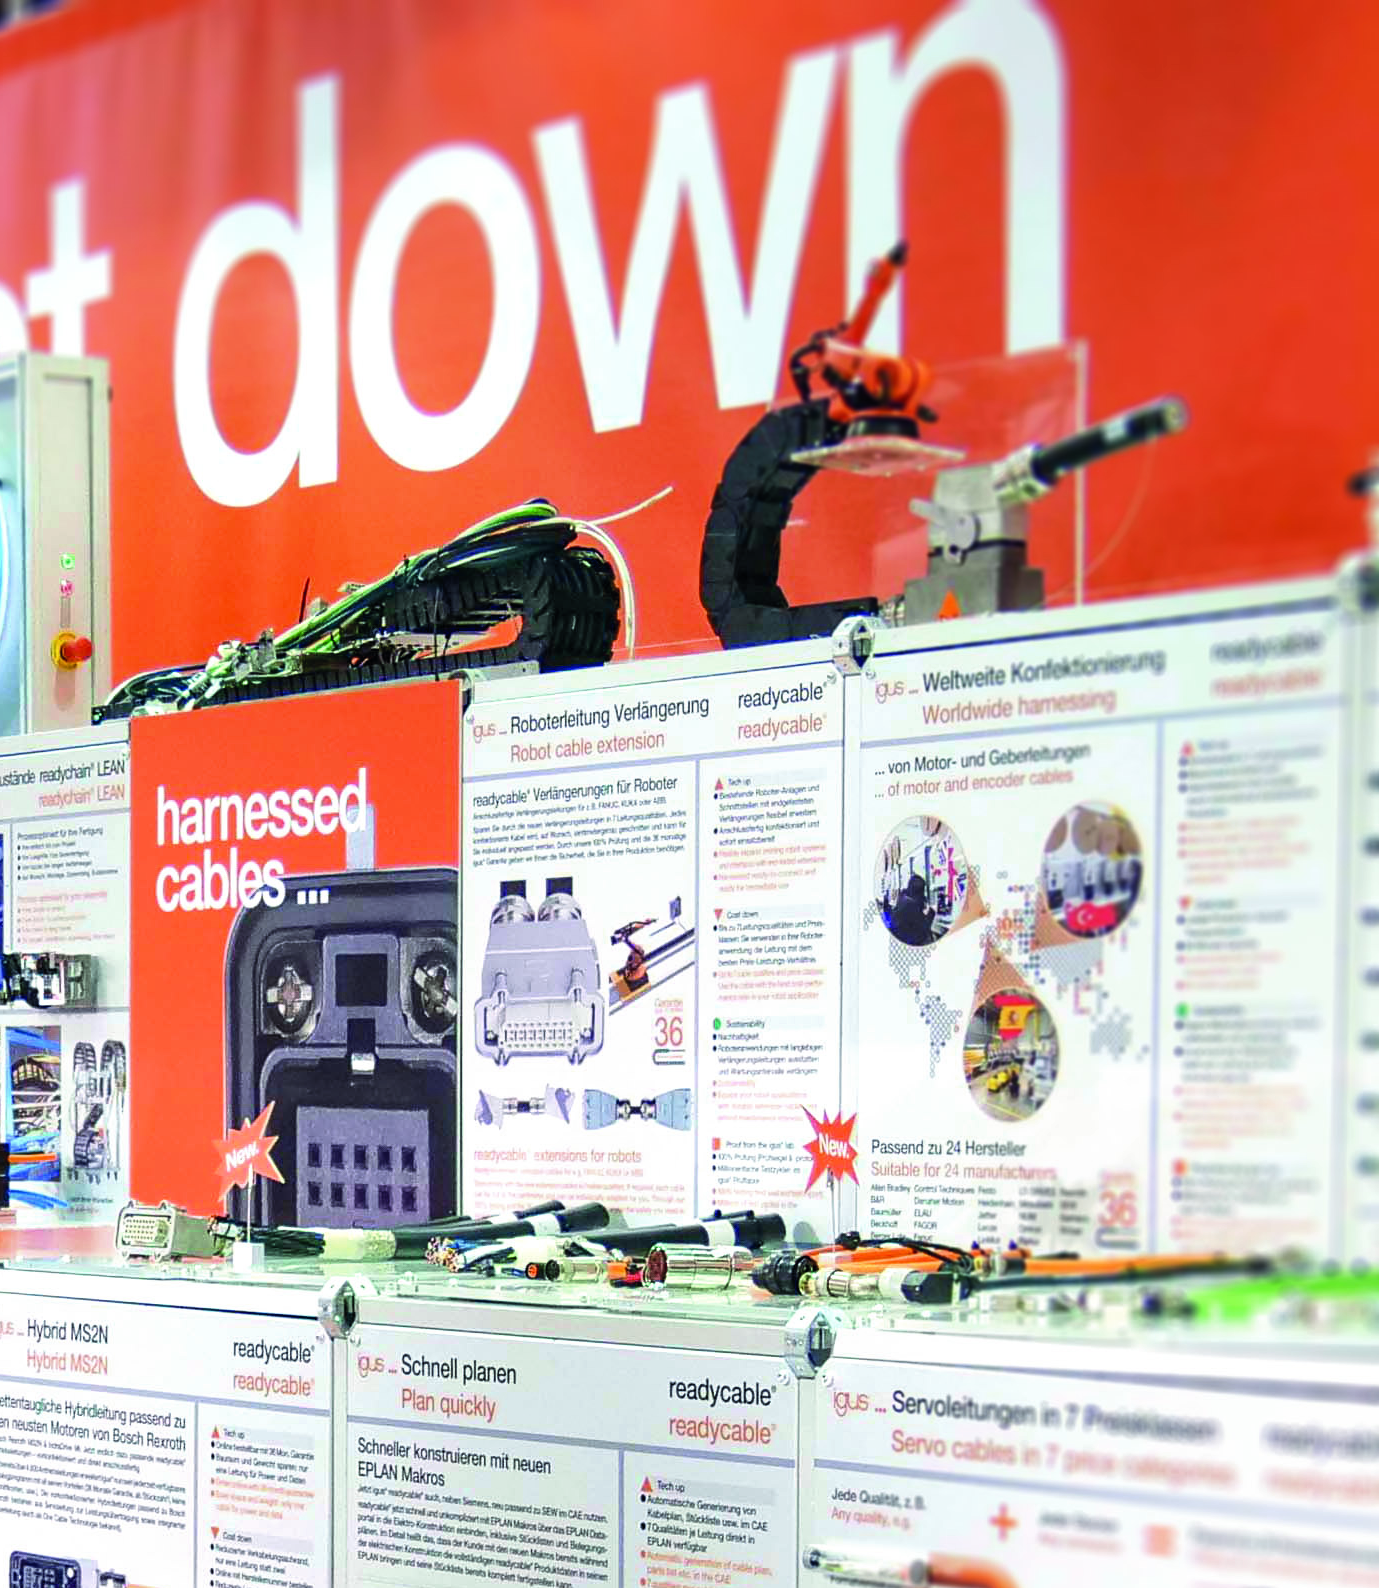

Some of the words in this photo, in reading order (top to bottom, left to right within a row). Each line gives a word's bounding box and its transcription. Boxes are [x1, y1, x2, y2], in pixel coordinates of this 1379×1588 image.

[174, 0, 1068, 507] down
[923, 669, 1005, 693] Weltweite
[1010, 650, 1165, 684] Konfektionierung
[511, 710, 610, 734] Roboterleitung
[614, 697, 710, 723] Verlängerung
[923, 698, 1013, 725] Worldwide
[1017, 687, 1116, 716] harnessing
[511, 743, 551, 762] Robot
[556, 738, 592, 758] cable
[597, 732, 665, 753] extension
[888, 760, 911, 774] von
[914, 755, 956, 772] Motor-
[960, 751, 985, 768] und
[989, 742, 1091, 767] Geberleitungen
[97, 760, 125, 777] LEAN
[903, 779, 941, 796] motor
[945, 774, 969, 792] and
[972, 771, 1025, 789] encoder
[1029, 766, 1074, 786] cables
[97, 784, 125, 801] LEAN
[534, 783, 613, 801] Verlängerungen
[634, 777, 678, 793] Roboter
[156, 767, 367, 846] harnessed
[156, 848, 286, 912] cables
[655, 1016, 683, 1046] 36
[225, 1141, 260, 1174] New.
[534, 1150, 587, 1162] extensions
[591, 1150, 604, 1163] for
[608, 1150, 641, 1163] robots
[819, 1132, 849, 1159] New.
[871, 1139, 924, 1155] Passend
[928, 1143, 941, 1155] zu
[947, 1141, 961, 1155] 24
[966, 1141, 1026, 1156] Hersteller
[871, 1161, 919, 1177] Suitable
[924, 1163, 940, 1177] for
[945, 1163, 959, 1177] 24
[964, 1163, 1057, 1181] manufacturers
[27, 1318, 67, 1343] Hybrid
[71, 1322, 108, 1344] MS2N
[27, 1348, 66, 1373] Hybrid
[71, 1353, 108, 1375] MS2N
[401, 1353, 458, 1380] Schnell
[463, 1359, 517, 1386] planen
[65, 1401, 126, 1426] Hybridleitung
[129, 1409, 171, 1427] passend
[174, 1417, 186, 1429] zu
[402, 1388, 434, 1412] Plan
[440, 1393, 496, 1423] quickly
[833, 1389, 869, 1416] igus
[892, 1389, 1037, 1430] Servoleitungen
[1042, 1404, 1061, 1427] in
[12, 1417, 48, 1433] neusten
[51, 1421, 89, 1439] Motoren
[92, 1429, 109, 1441] von
[112, 1428, 144, 1447] Bosch
[147, 1432, 186, 1452] Rexroth
[358, 1437, 411, 1457] Schneller
[413, 1443, 486, 1467] konstruieren
[490, 1452, 509, 1470] mit
[513, 1457, 551, 1474] neuen
[891, 1428, 946, 1457] Servo
[951, 1439, 1018, 1465] cables
[1023, 1441, 1040, 1466] in
[1044, 1443, 1061, 1467] 7
[1063, 1447, 1116, 1476] price
[358, 1461, 398, 1481] EPLAN
[401, 1466, 445, 1486] Makros
[831, 1487, 858, 1503] Jede
[859, 1490, 904, 1511] Qualität,
[831, 1506, 854, 1523] Any
[856, 1509, 890, 1528] quality,
